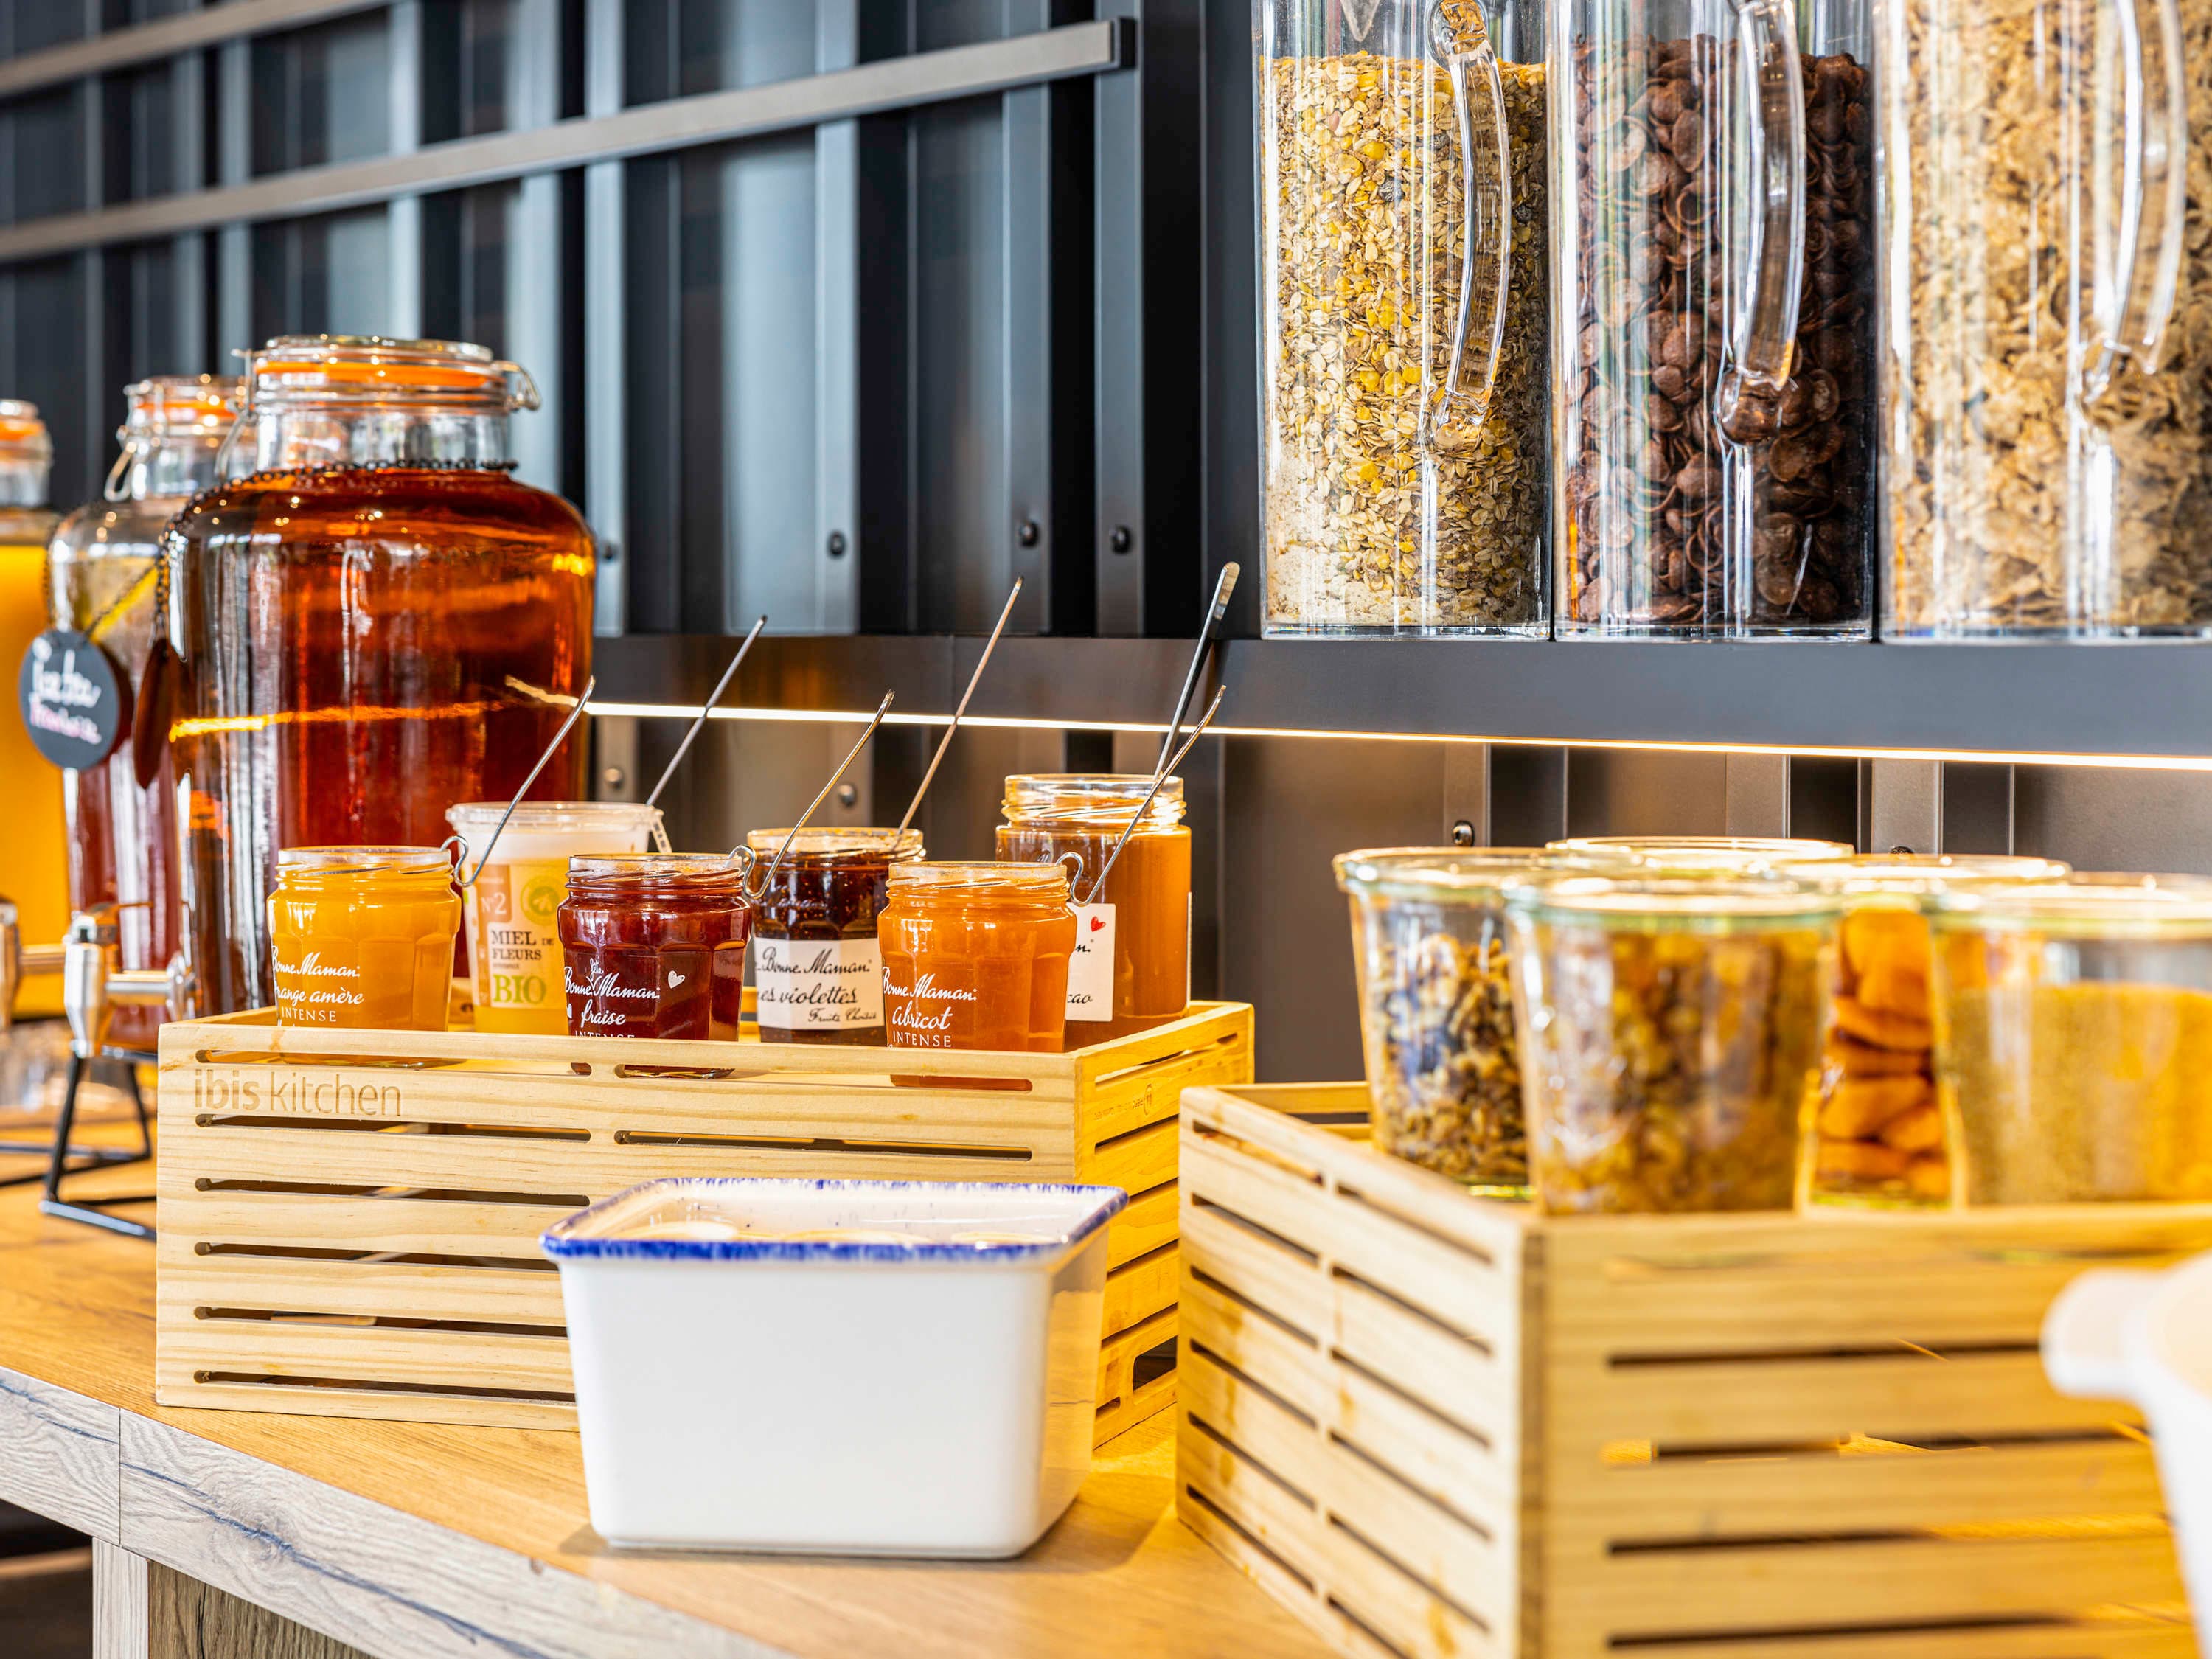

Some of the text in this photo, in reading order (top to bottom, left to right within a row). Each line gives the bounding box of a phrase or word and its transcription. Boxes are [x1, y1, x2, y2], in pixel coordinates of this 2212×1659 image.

[492, 931, 554, 946] MIEL DE
[271, 945, 296, 974] Bonne
[492, 949, 542, 960] FLEURS
[762, 946, 801, 974] Bonne
[274, 981, 364, 1006] range amère
[493, 974, 546, 1004] BIO
[564, 967, 592, 995] Bonne
[779, 983, 858, 1004] violettes
[883, 967, 908, 997] Bonne
[282, 1006, 336, 1022] INTENSE
[580, 999, 626, 1028] fraise
[893, 1031, 951, 1048] INTENSE
[195, 1069, 401, 1116] ibis kitchen
